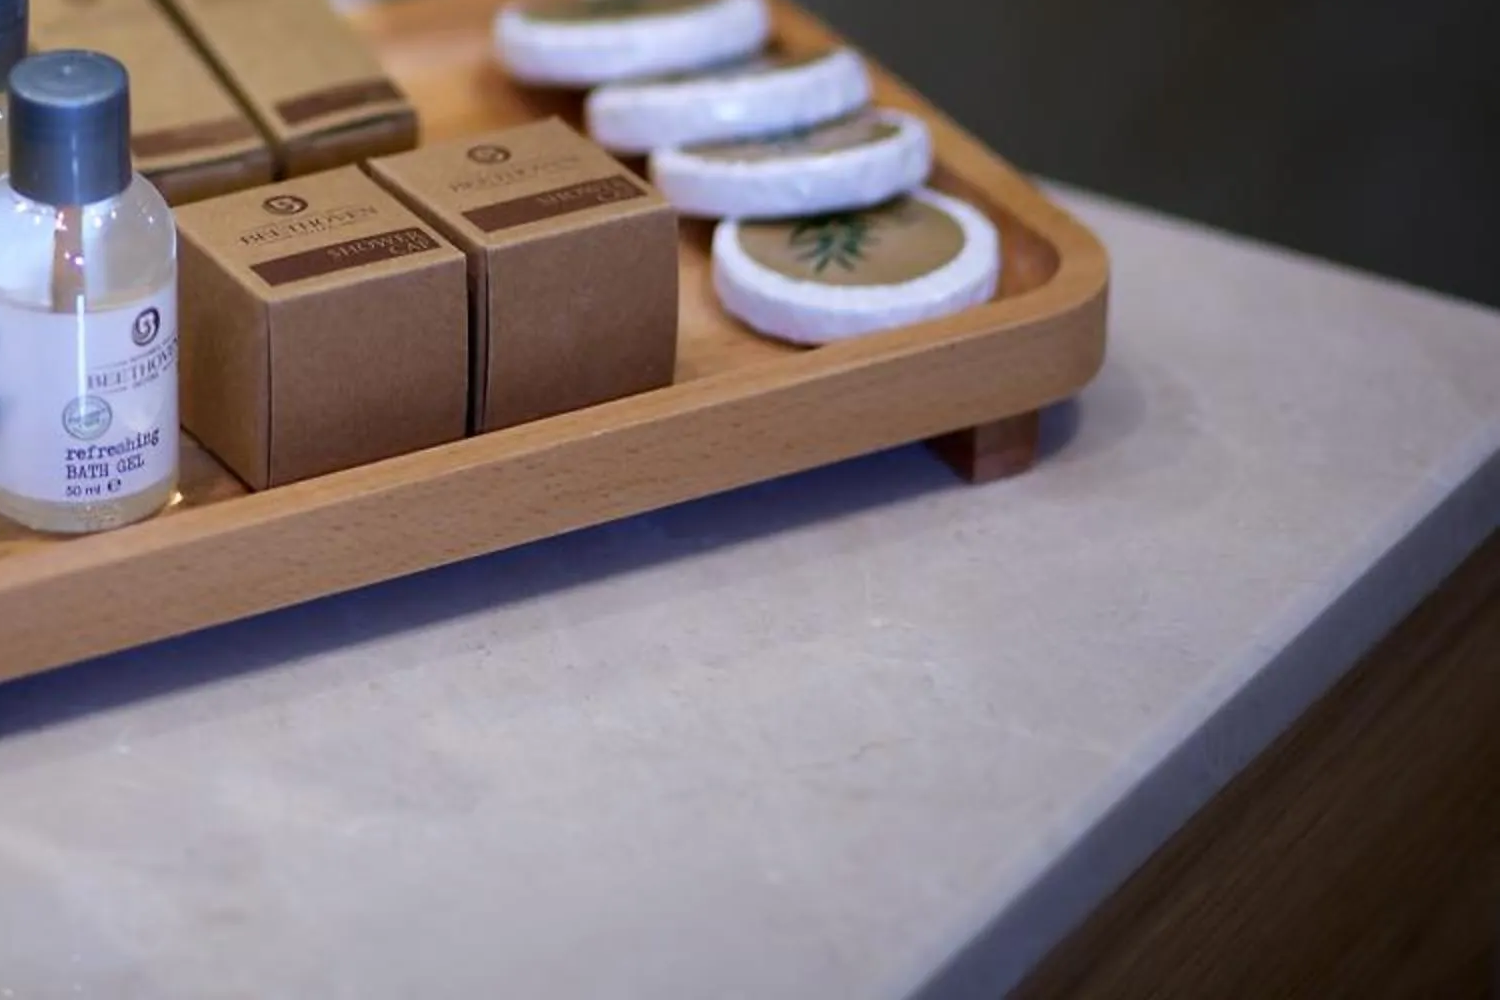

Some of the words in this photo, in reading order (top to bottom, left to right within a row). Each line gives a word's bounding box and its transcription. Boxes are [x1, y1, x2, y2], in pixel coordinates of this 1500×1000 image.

[239, 205, 379, 246] BEETHOVEN
[326, 230, 424, 260] SHOWER
[389, 239, 431, 256] CAP
[65, 427, 160, 461] refreshing
[65, 463, 109, 479] BATH
[116, 453, 145, 473] GEL
[65, 485, 81, 497] 50
